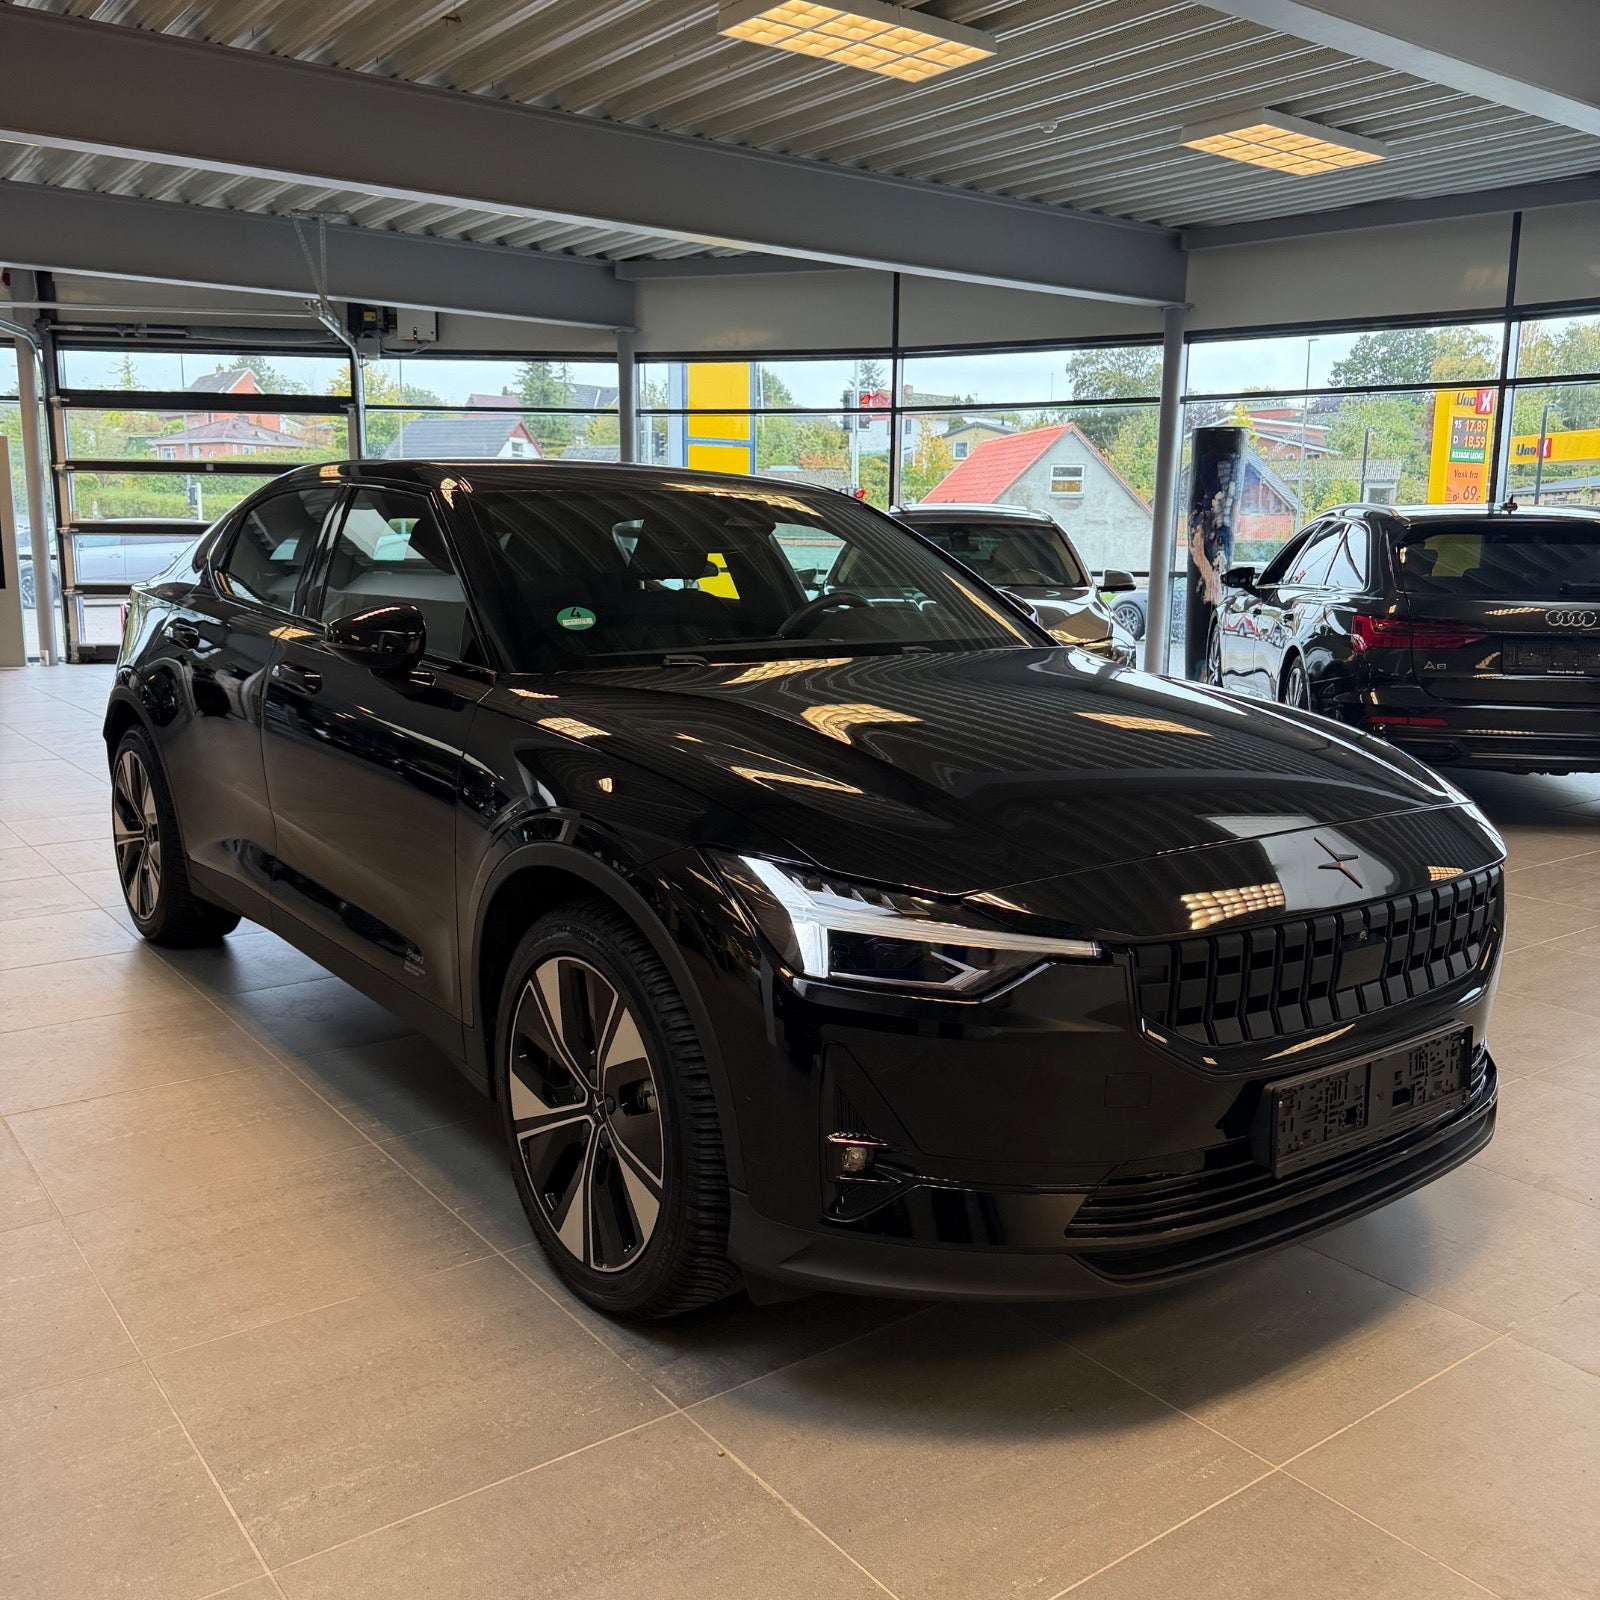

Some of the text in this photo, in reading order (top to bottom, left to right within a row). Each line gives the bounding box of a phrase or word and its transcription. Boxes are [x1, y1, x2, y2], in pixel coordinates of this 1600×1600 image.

[1456, 391, 1492, 412] Uno X
[1454, 420, 1487, 433] 95 17,89
[1452, 435, 1486, 448] D 18,59
[570, 607, 581, 618] 4
